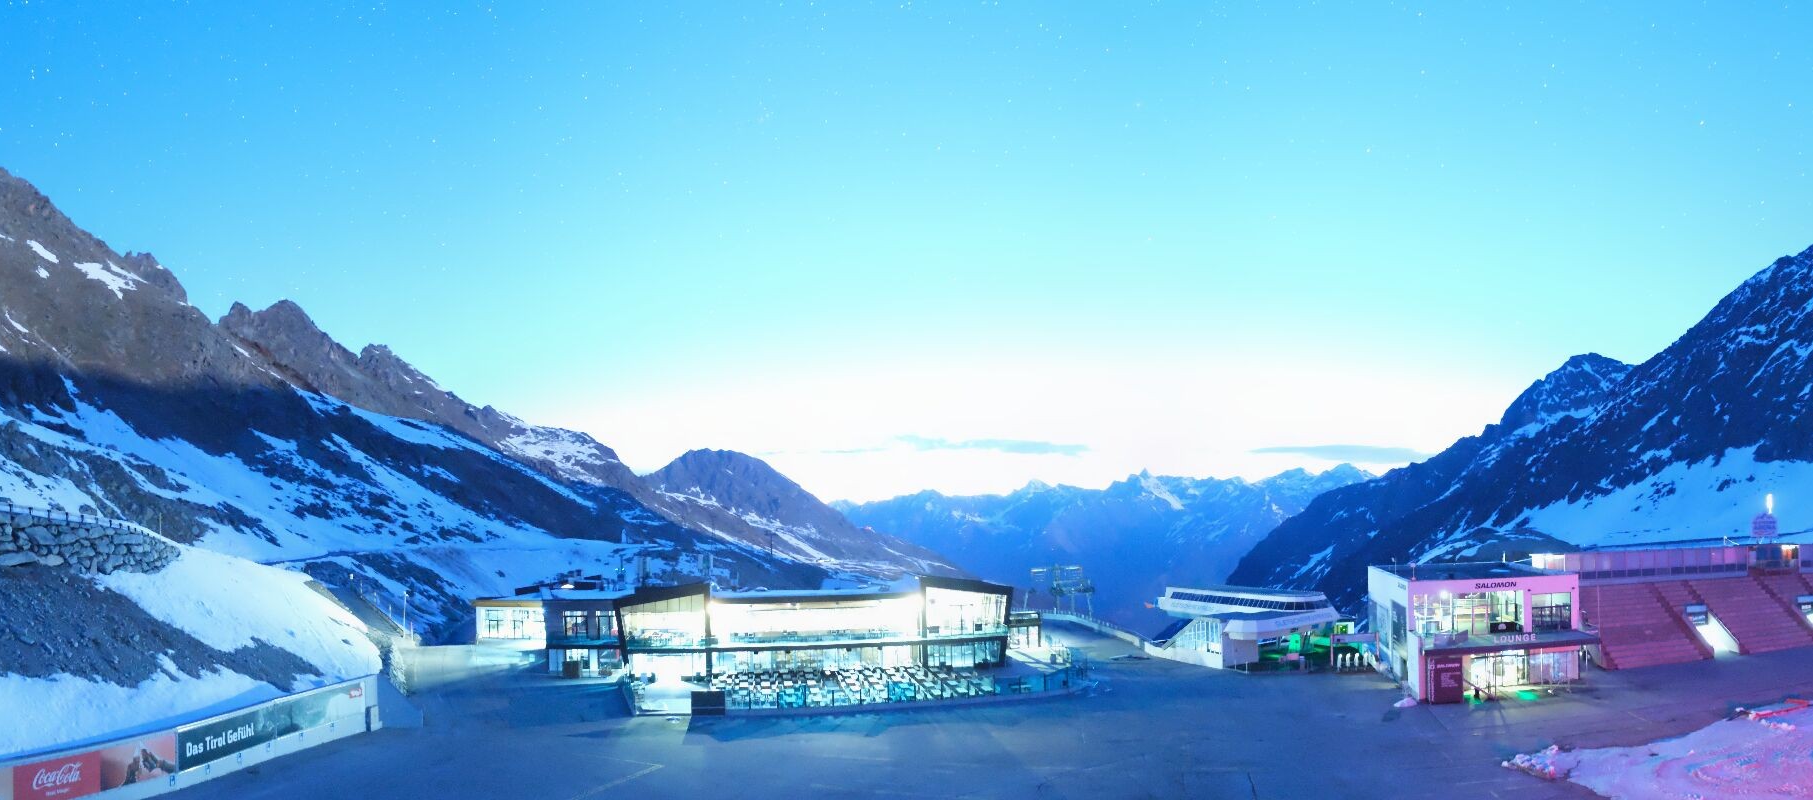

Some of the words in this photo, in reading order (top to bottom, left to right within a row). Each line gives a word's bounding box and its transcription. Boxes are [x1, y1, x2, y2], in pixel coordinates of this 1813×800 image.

[1475, 581, 1517, 590] SALOMON
[1493, 633, 1537, 644] LOUNGE
[186, 741, 204, 758] Das
[205, 731, 226, 751] Tirol
[227, 722, 255, 744] Gefühl
[32, 761, 83, 790] Coca-Cola
